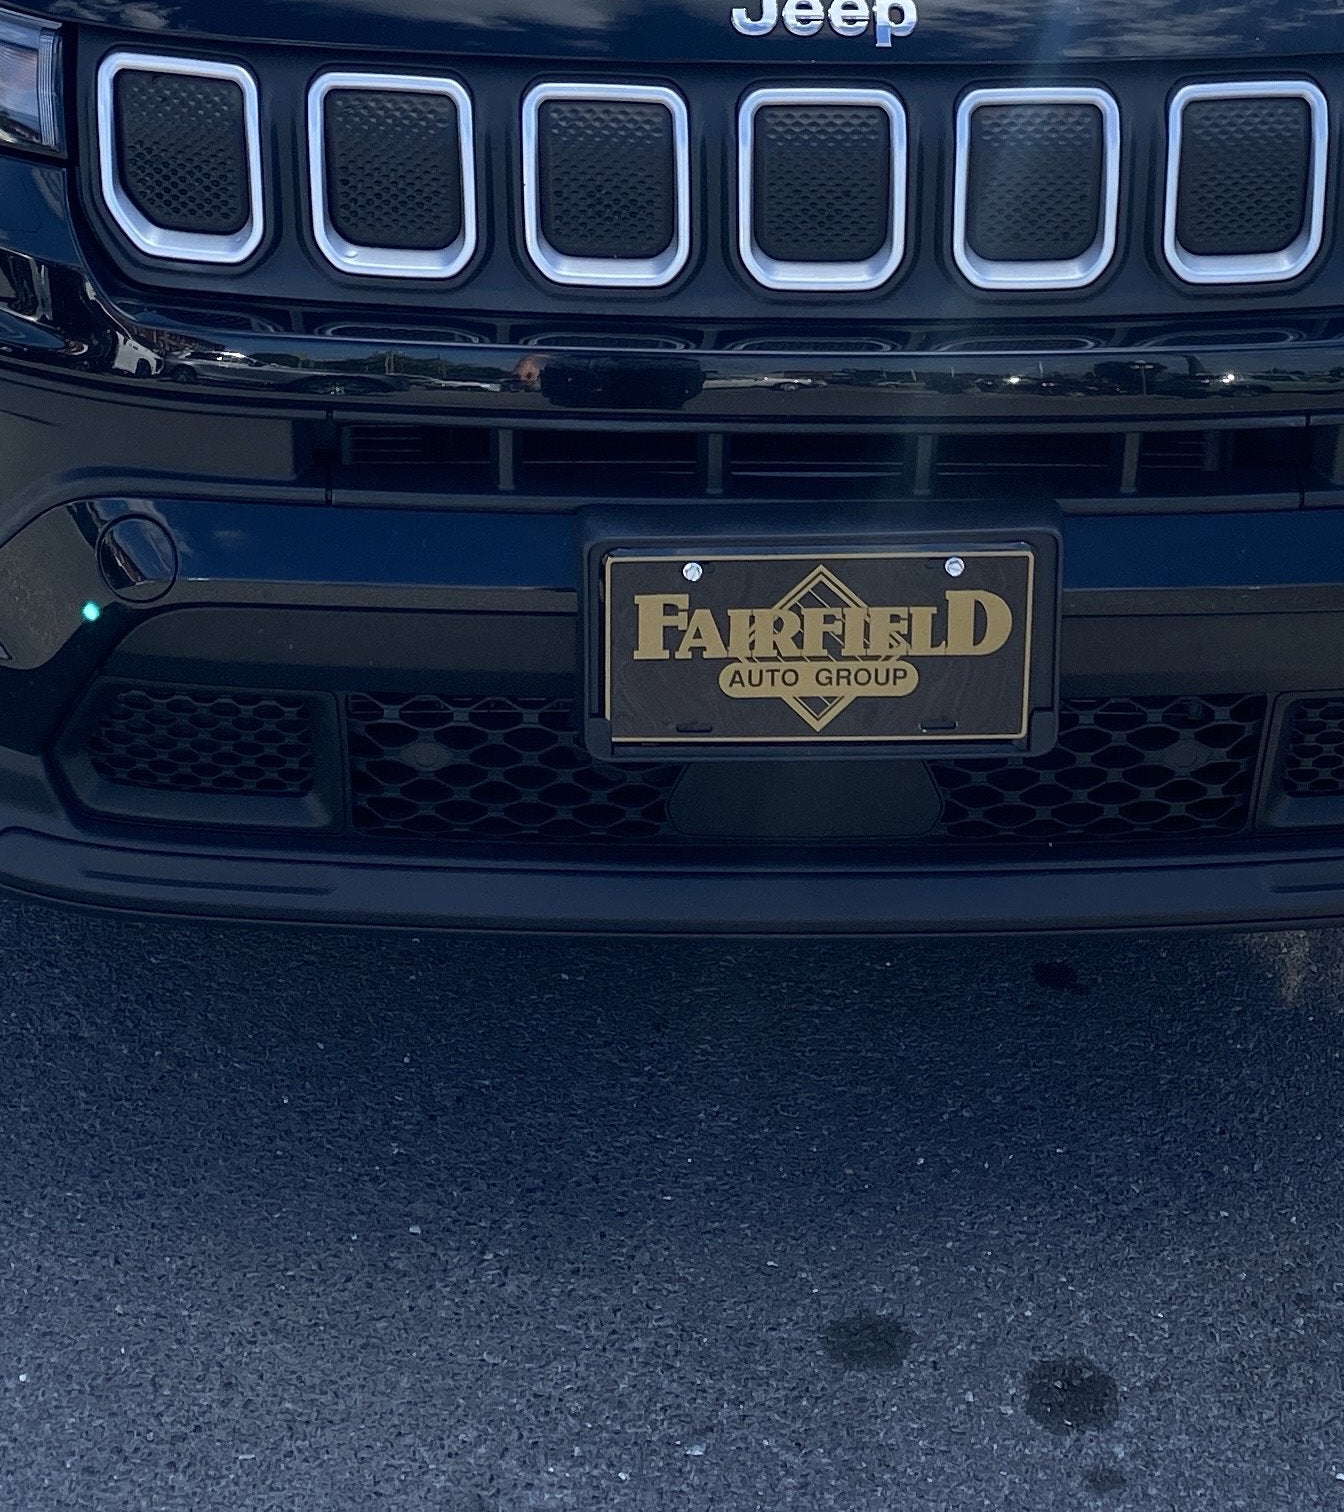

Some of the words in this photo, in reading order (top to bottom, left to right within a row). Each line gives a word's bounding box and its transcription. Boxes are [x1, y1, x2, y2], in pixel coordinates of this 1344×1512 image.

[633, 590, 1013, 660] FAIRFIELD
[728, 668, 800, 689] AUTO
[815, 667, 908, 688] GROUP
